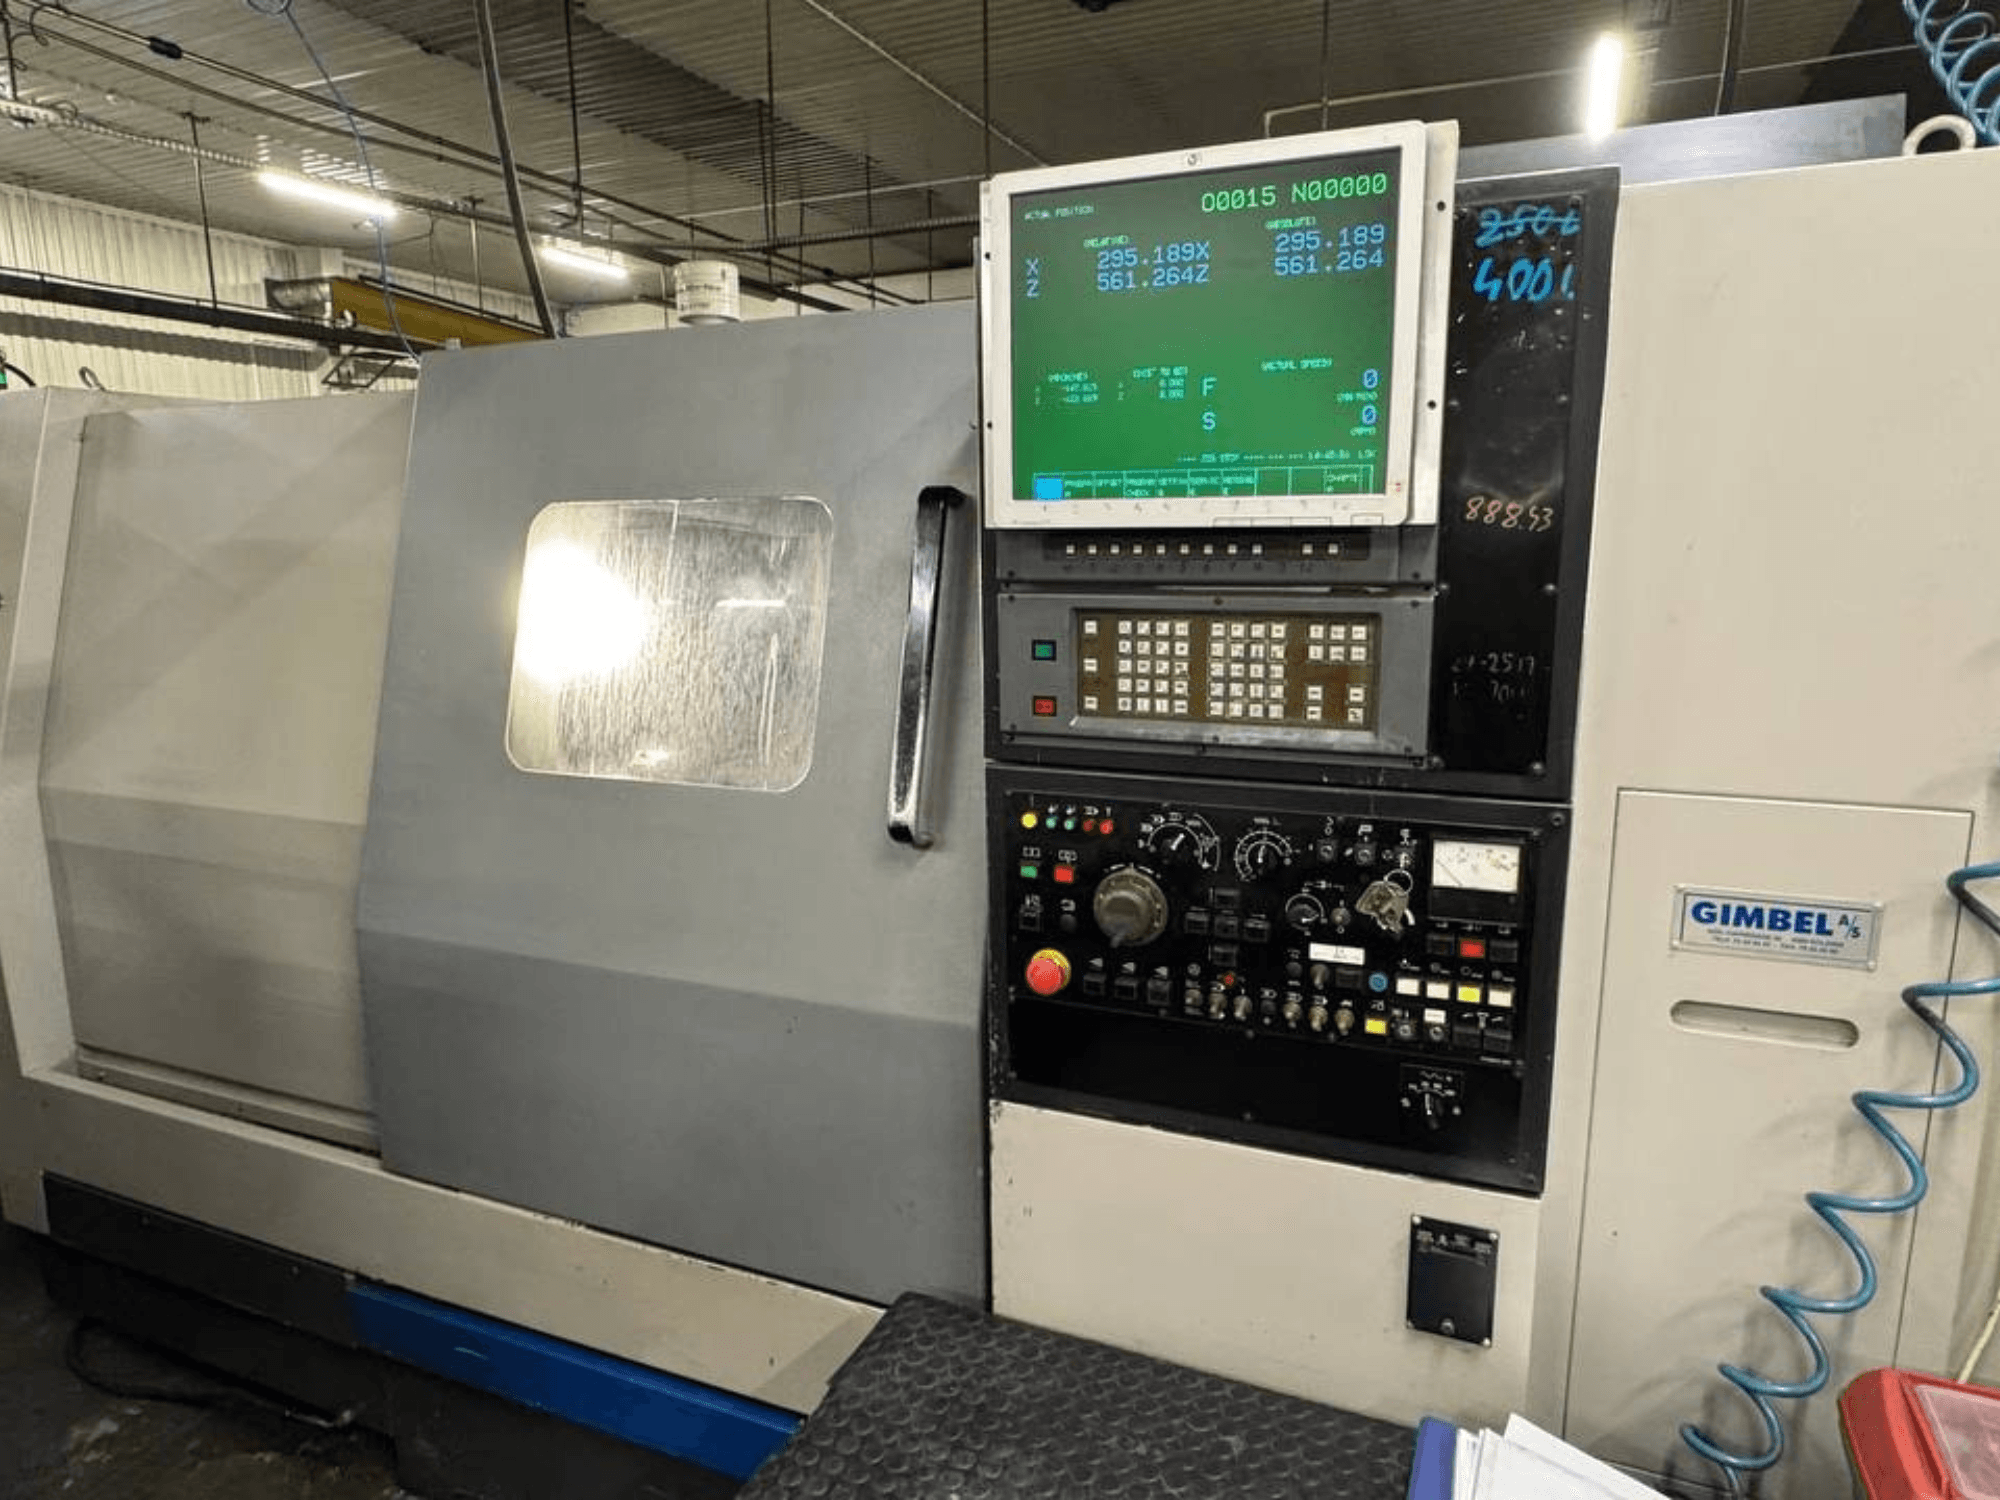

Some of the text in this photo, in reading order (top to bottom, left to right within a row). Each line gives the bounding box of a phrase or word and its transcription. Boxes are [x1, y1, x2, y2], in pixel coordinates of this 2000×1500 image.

[1292, 173, 1387, 203] N00000
[1026, 258, 1039, 276] X
[1275, 223, 1385, 253] 295.189
[1027, 279, 1039, 297] Z
[1274, 248, 1383, 276] 561.264
[1203, 377, 1217, 397] F
[1363, 368, 1378, 389] 0
[1202, 404, 1377, 431] S 0
[1691, 901, 1834, 936] GIMBEL
[1838, 914, 1861, 939] A/S
